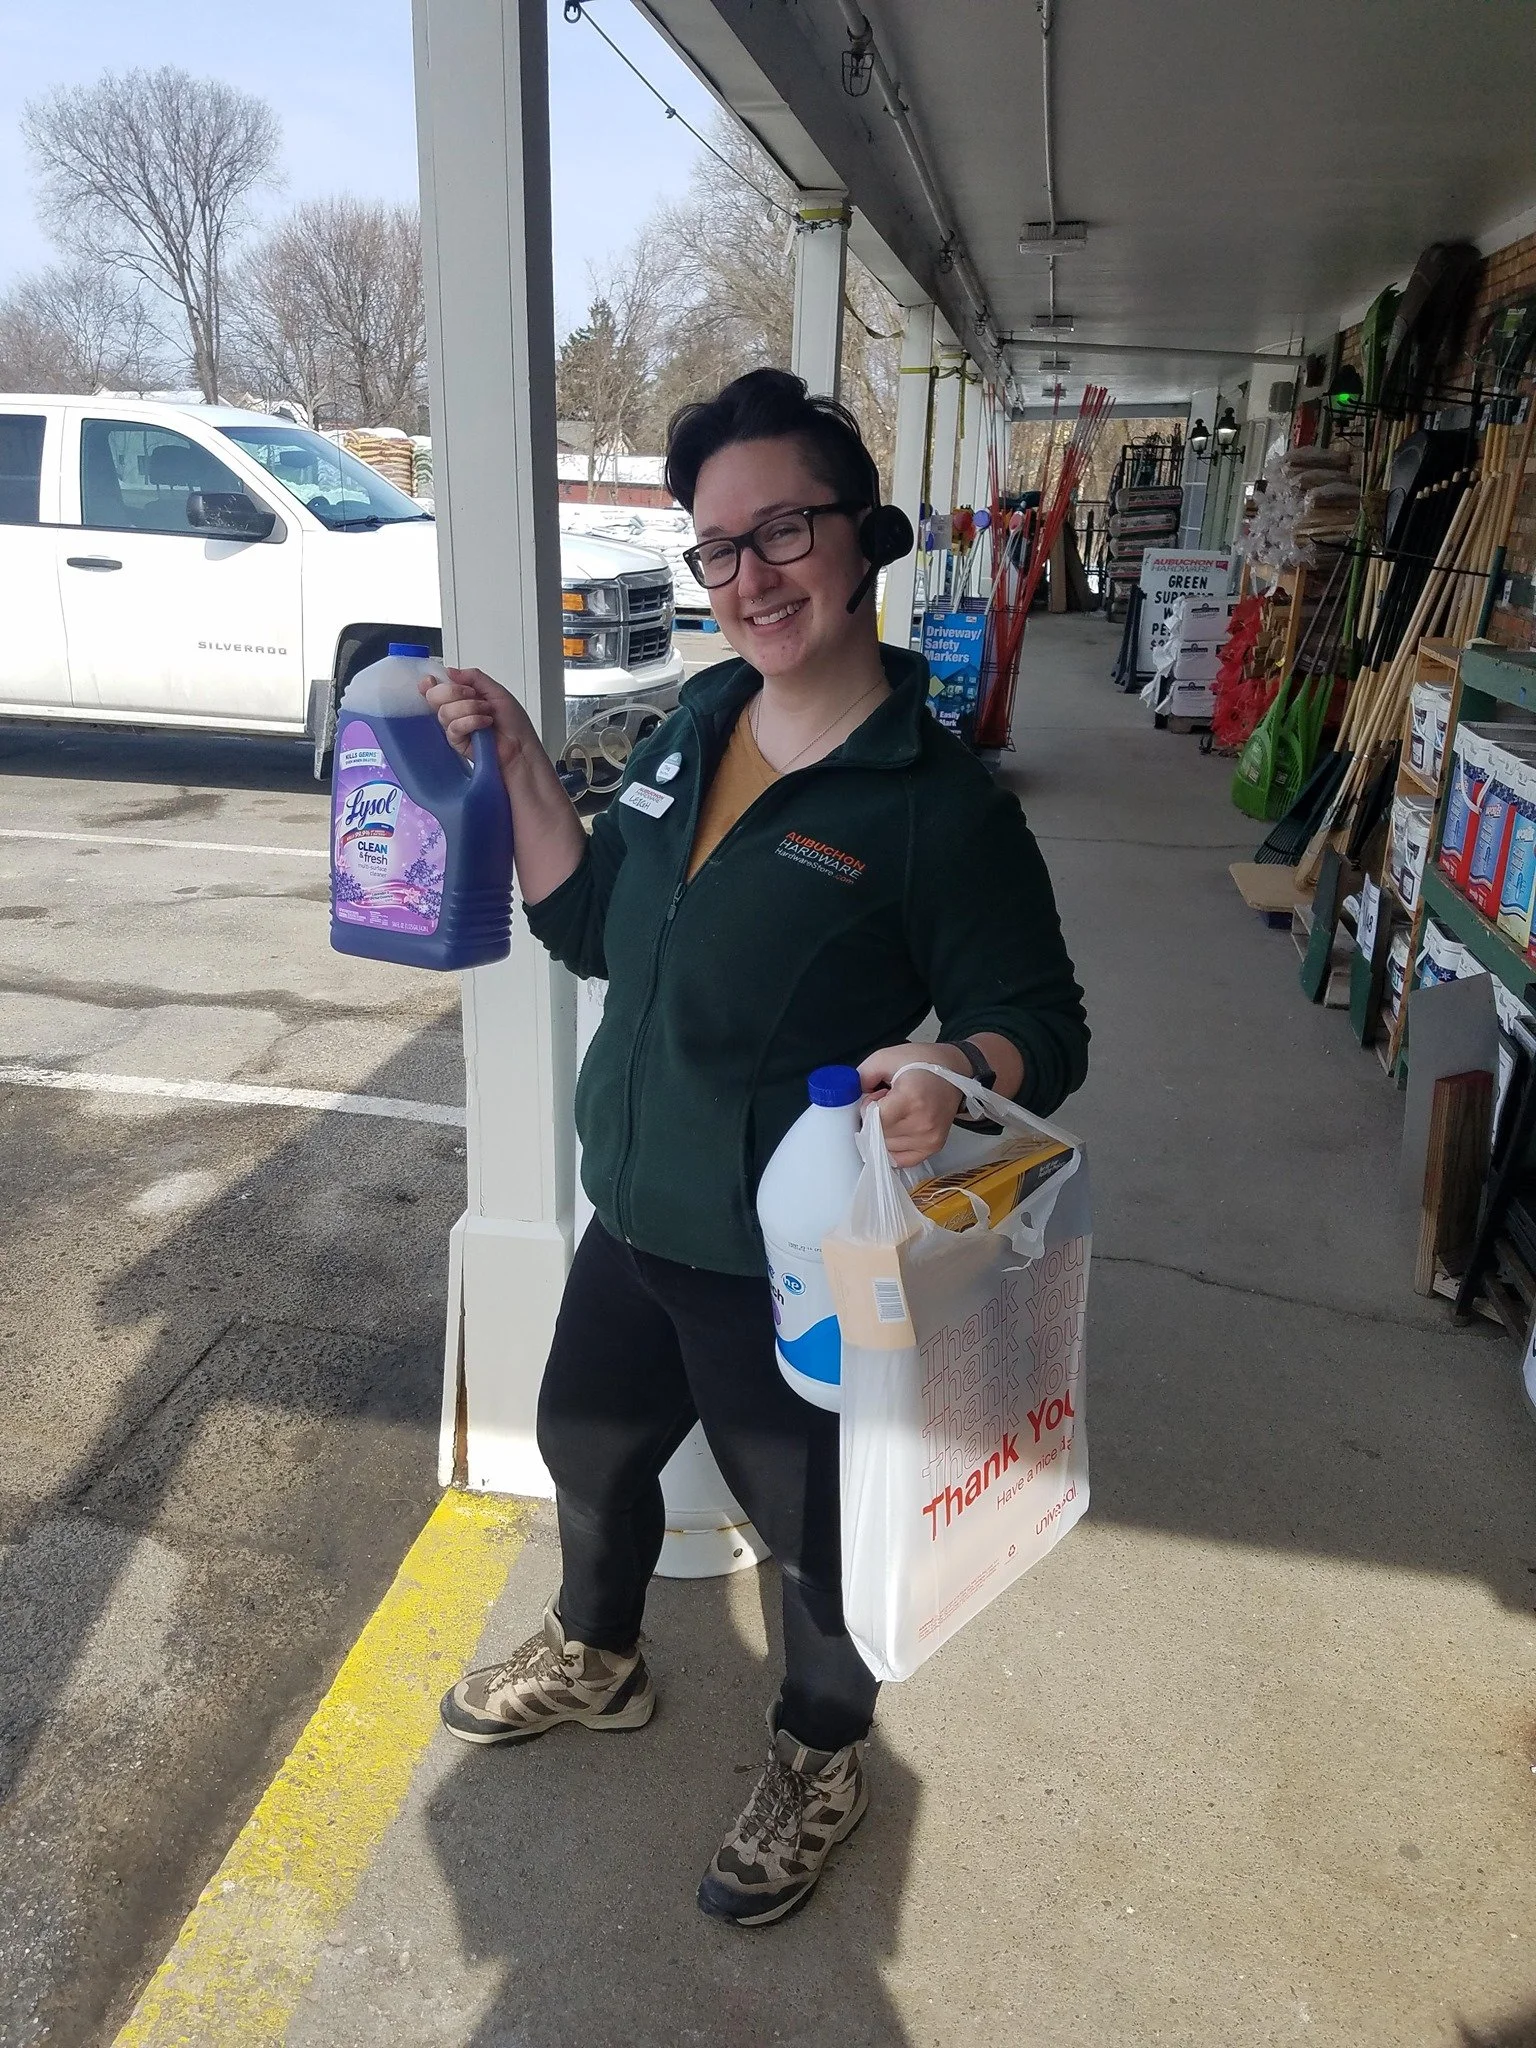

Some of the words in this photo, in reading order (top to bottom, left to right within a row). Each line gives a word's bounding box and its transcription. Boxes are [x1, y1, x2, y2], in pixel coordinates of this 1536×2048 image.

[1151, 565, 1211, 573] HARDWARE
[1153, 558, 1215, 567] AUBUCHON
[1168, 575, 1208, 590] GREEN
[926, 625, 982, 640] Driveway/
[198, 641, 287, 655] SILVERADO
[924, 638, 960, 652] Safety
[924, 650, 970, 663] Markers
[939, 711, 960, 720] Easily
[939, 719, 957, 727] Mark
[345, 752, 358, 760] KILLS
[345, 788, 398, 829] Lysol
[358, 841, 388, 855] CLEAN
[785, 831, 866, 870] AUBUCHON
[364, 851, 388, 866] fresh
[778, 839, 862, 880] HARDWARE
[358, 863, 388, 872] multi-surface
[369, 870, 388, 878] cleaner
[783, 1276, 802, 1291] he
[919, 1278, 1019, 1383] Thank
[1026, 1235, 1085, 1294] You
[920, 1319, 1019, 1423] Thank
[1025, 1273, 1085, 1334] You
[921, 1357, 1020, 1463] Thank
[1025, 1311, 1085, 1371] You
[921, 1396, 1020, 1500] Thank
[1025, 1350, 1082, 1407] You
[922, 1432, 1020, 1541] Thank
[996, 1478, 1024, 1511] Have
[1026, 1468, 1034, 1483] a
[1035, 1447, 1058, 1475] nice
